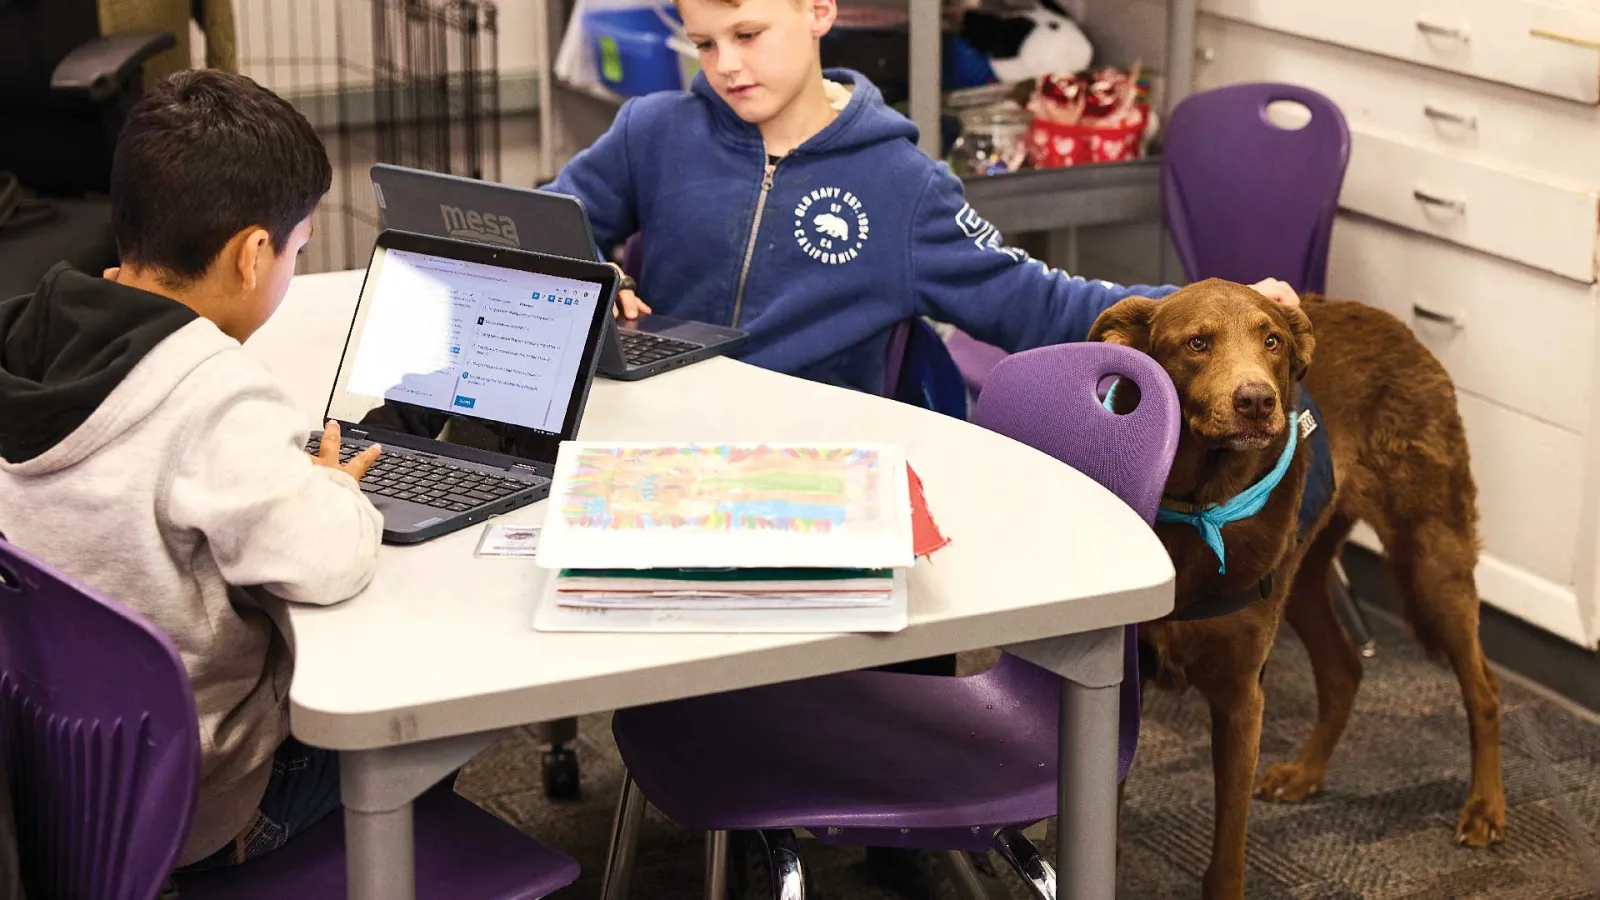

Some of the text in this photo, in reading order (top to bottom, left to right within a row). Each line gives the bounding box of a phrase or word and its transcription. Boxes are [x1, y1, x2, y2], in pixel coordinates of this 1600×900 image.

[440, 204, 519, 244] mesa
[794, 187, 869, 240] OLD NAVY EST. 1994
[794, 228, 858, 264] CALIFORNIA
[820, 238, 832, 249] CA
